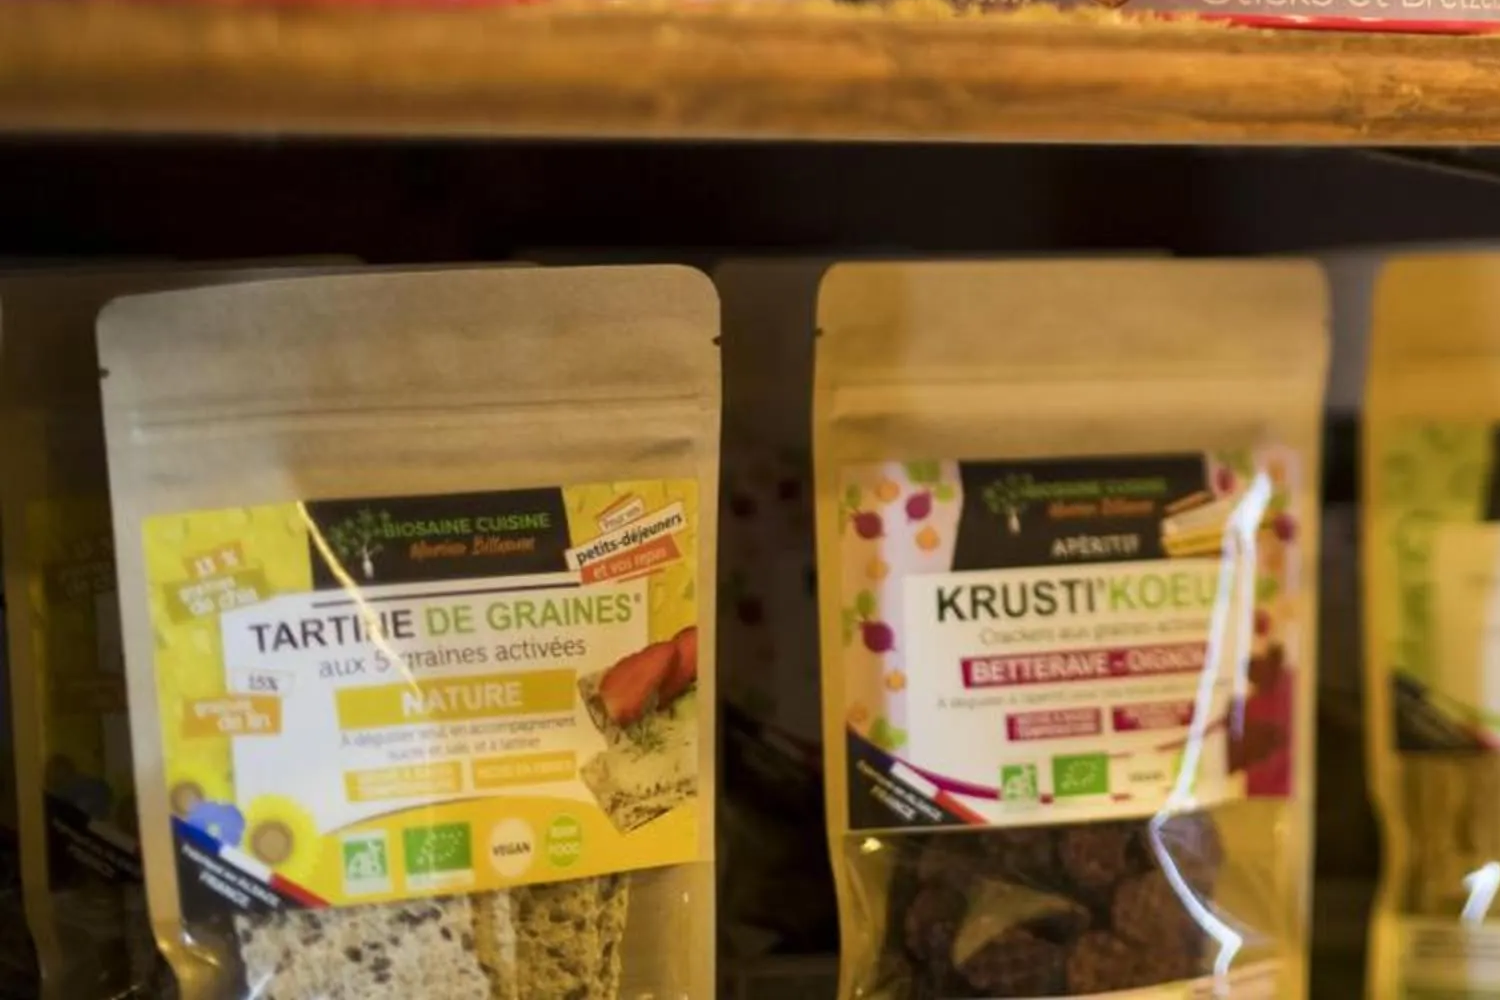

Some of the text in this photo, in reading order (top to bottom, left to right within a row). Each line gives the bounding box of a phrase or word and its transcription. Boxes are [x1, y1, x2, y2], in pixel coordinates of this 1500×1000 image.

[383, 511, 553, 538] BIOSAINE CUISINE
[575, 510, 684, 567] petits-déjeuners
[425, 604, 477, 638] DE
[486, 591, 634, 633] GRAINES
[936, 573, 1217, 622] KRUSTI'KOEU
[318, 656, 366, 680] aux
[373, 650, 392, 674] 5
[494, 635, 587, 662] activées
[970, 652, 1110, 683] BETTERAVE
[401, 681, 523, 717] NATURE
[492, 841, 531, 857] VEGAN
